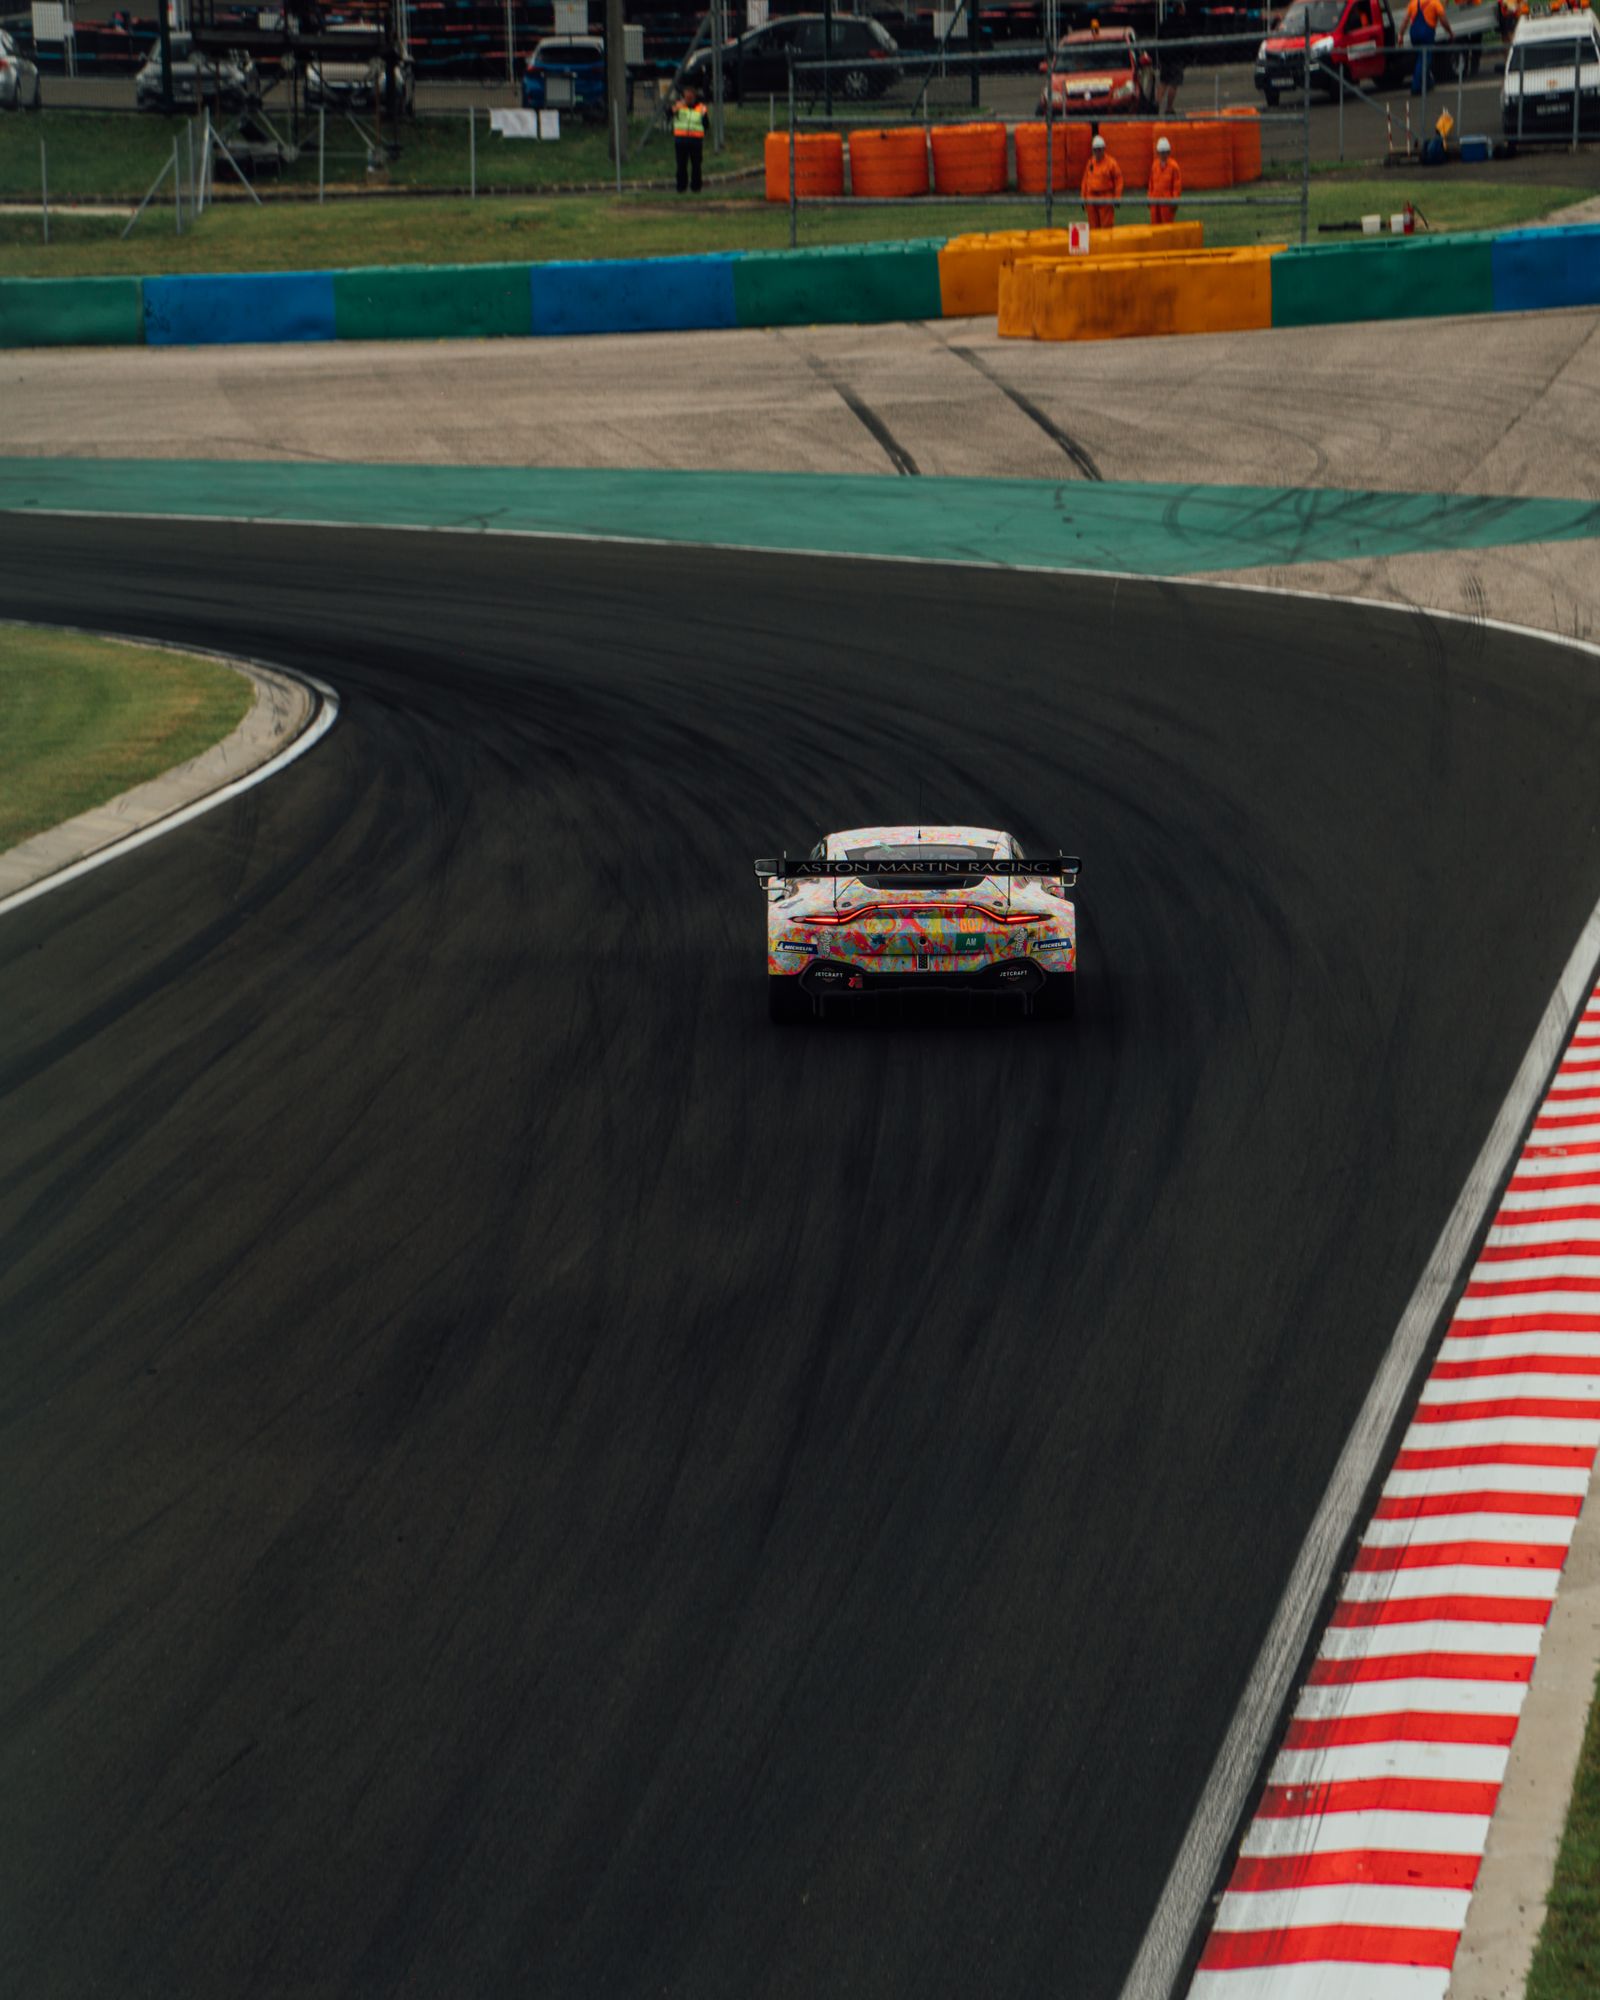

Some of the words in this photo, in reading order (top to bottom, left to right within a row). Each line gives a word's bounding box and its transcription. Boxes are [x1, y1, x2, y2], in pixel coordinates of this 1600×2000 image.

[796, 862, 870, 873] ASTON
[877, 862, 960, 872] MARTIN
[968, 862, 1050, 872] RACING
[965, 937, 977, 946] AM
[1039, 941, 1067, 949] MICHELIN
[784, 944, 814, 952] MICHELIN
